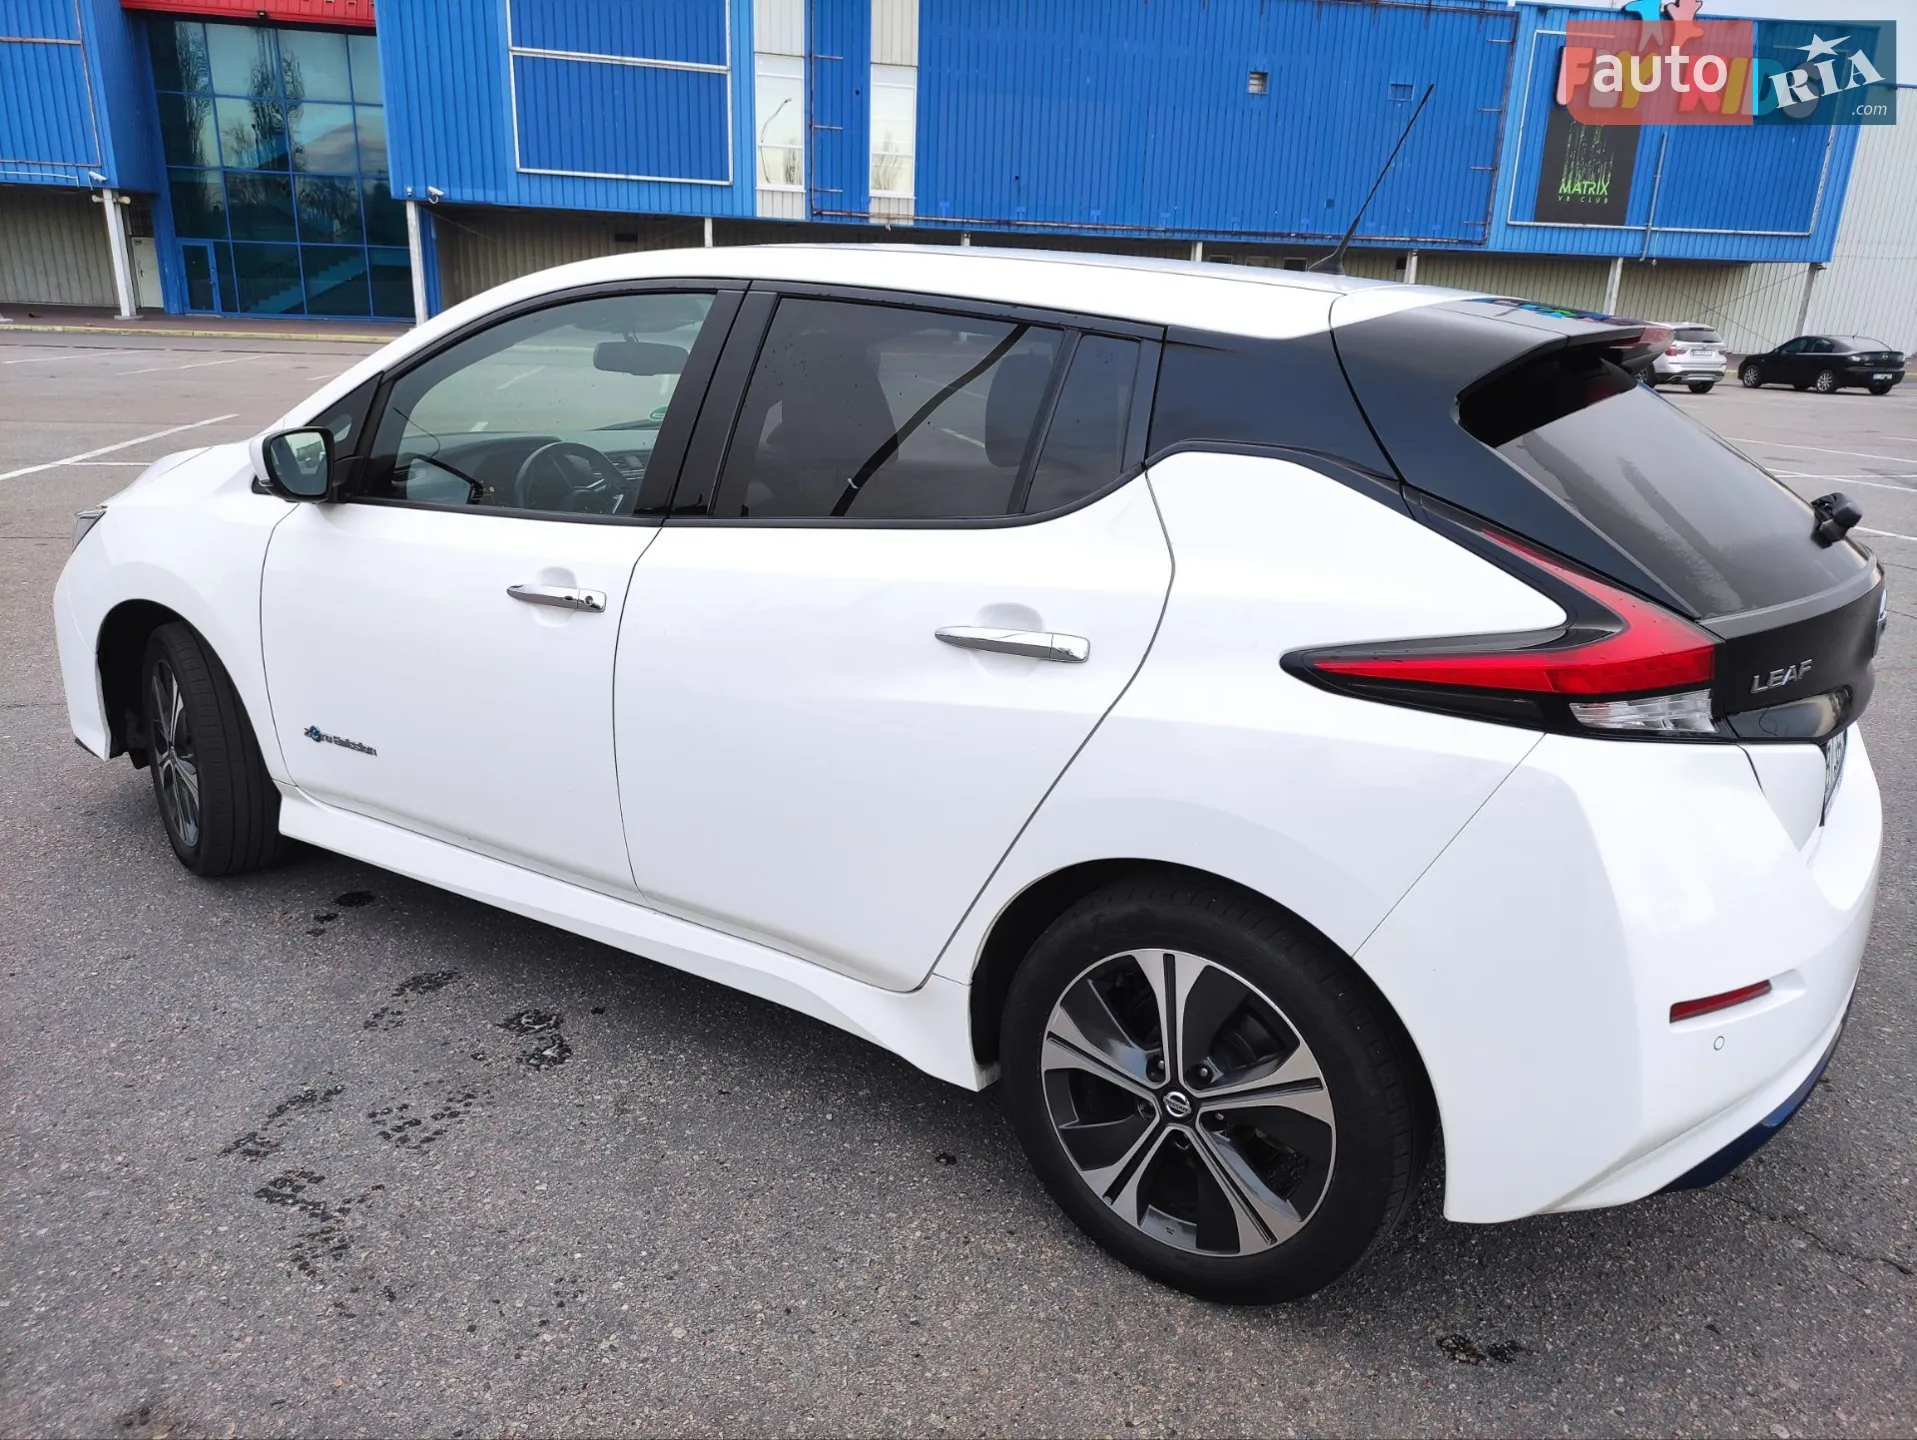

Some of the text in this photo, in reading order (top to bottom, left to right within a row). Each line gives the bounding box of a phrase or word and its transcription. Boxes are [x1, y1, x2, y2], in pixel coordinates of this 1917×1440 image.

[1678, 53, 1820, 119] KIDS
[1558, 177, 1610, 196] MATRIX
[1750, 658, 1813, 694] LEAF
